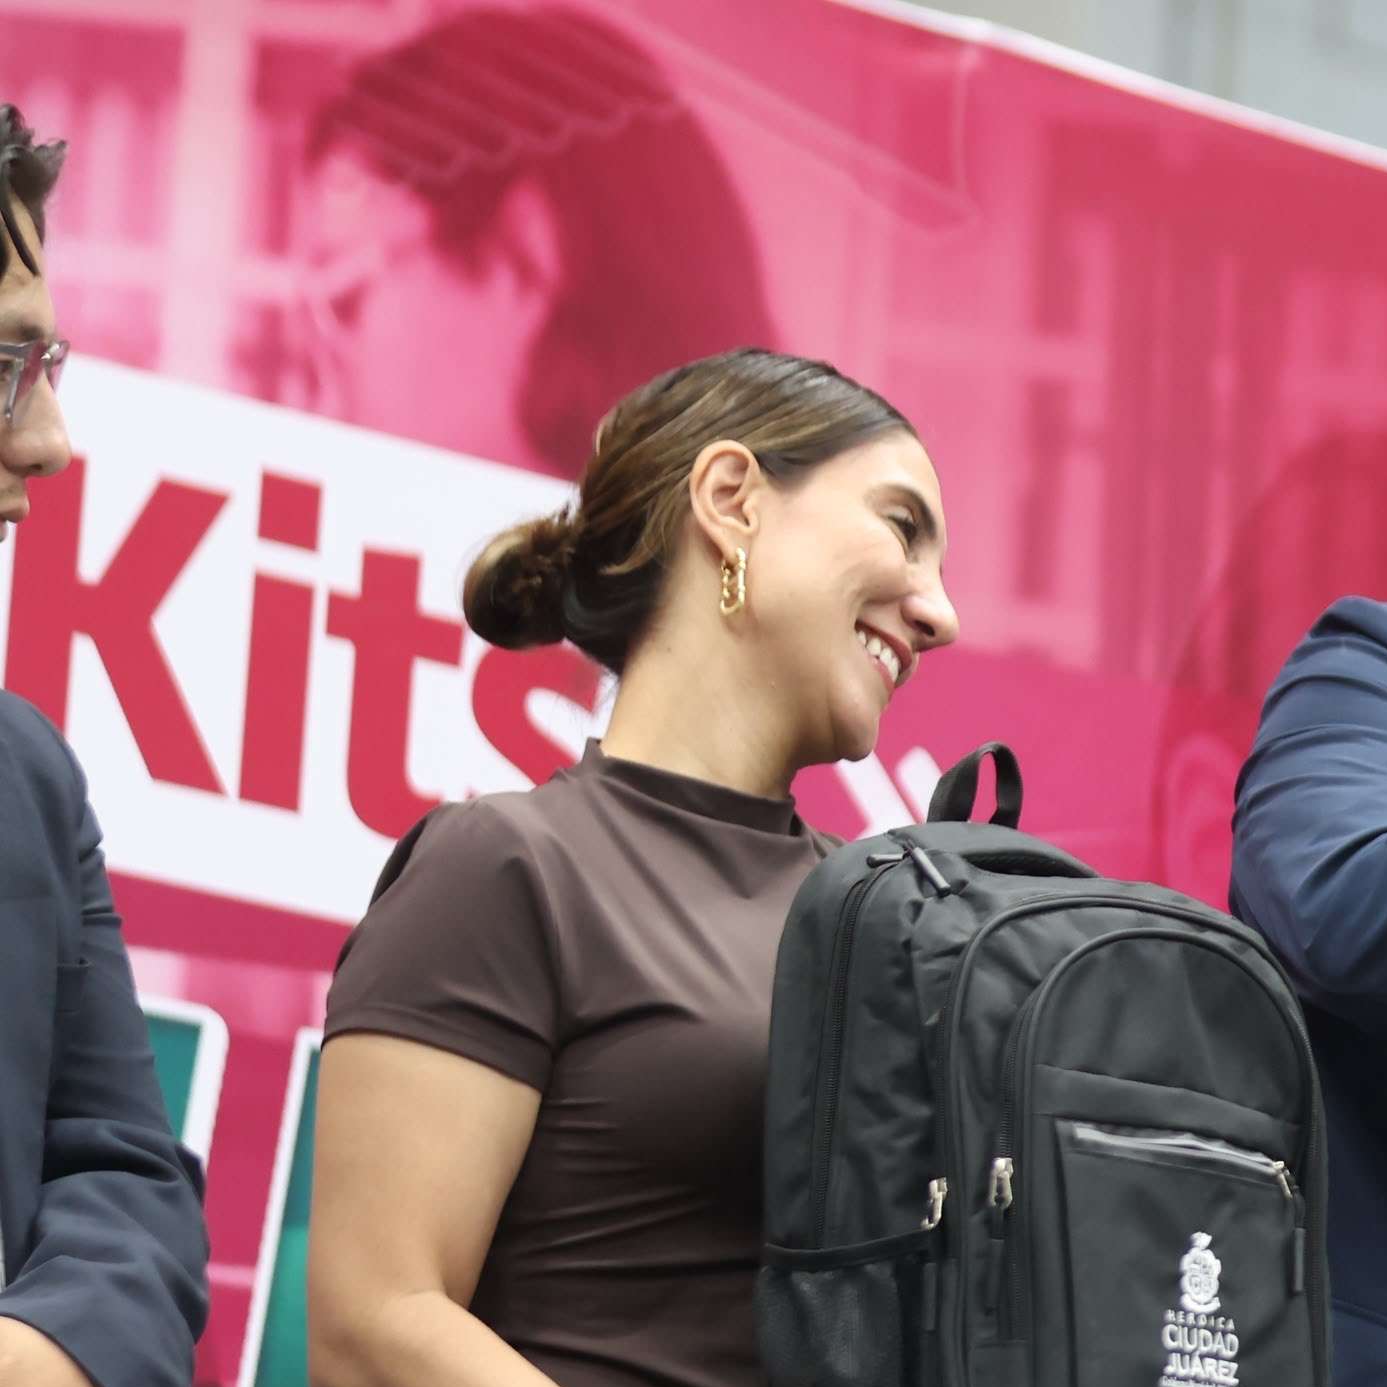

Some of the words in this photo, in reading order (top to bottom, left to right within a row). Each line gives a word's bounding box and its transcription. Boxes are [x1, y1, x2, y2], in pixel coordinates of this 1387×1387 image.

[3, 454, 606, 842] Kits
[1165, 1309, 1235, 1331] HEROICA
[1162, 1324, 1239, 1359] CIUDAD
[1163, 1351, 1239, 1385] JUÁREZ
